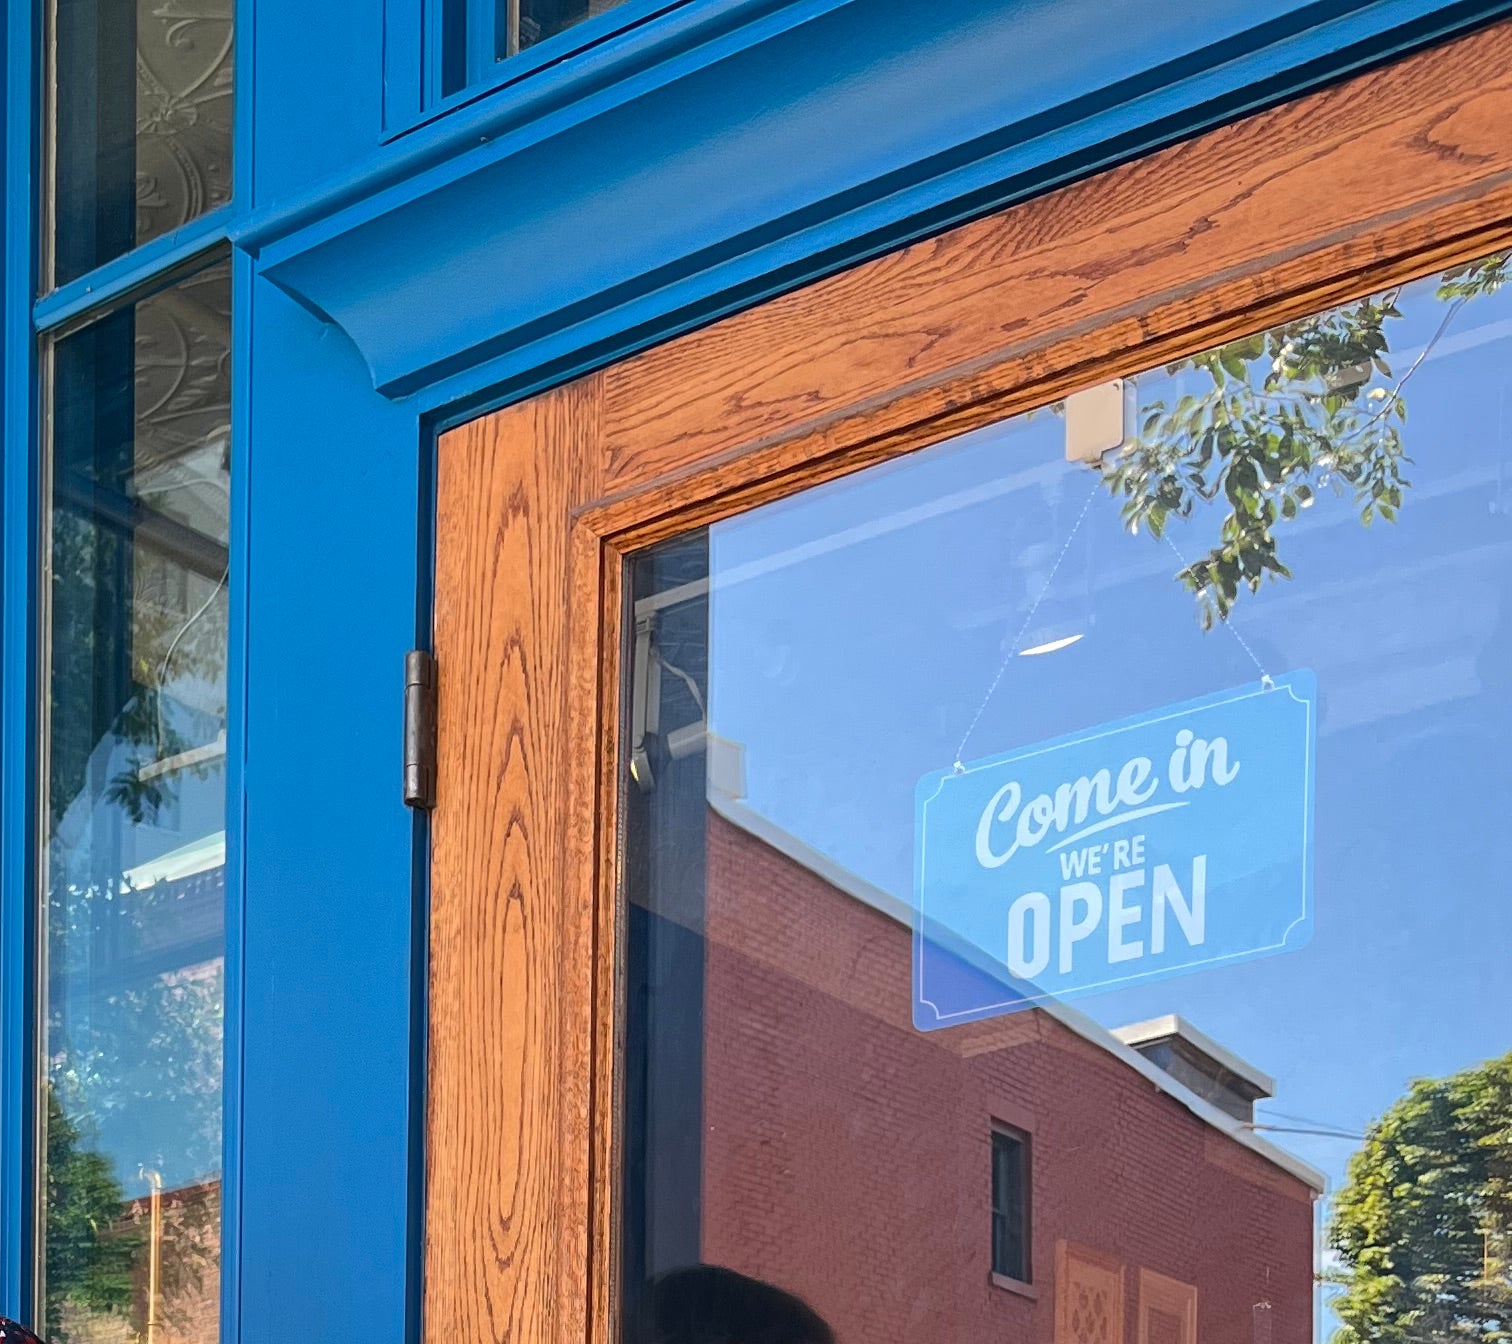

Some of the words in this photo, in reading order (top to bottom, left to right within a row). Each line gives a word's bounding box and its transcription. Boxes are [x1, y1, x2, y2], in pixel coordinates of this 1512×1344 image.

[976, 757, 1158, 868] Come
[1169, 729, 1240, 792] in
[1060, 835, 1145, 880] WE'RE
[1008, 855, 1207, 978] OPEN
